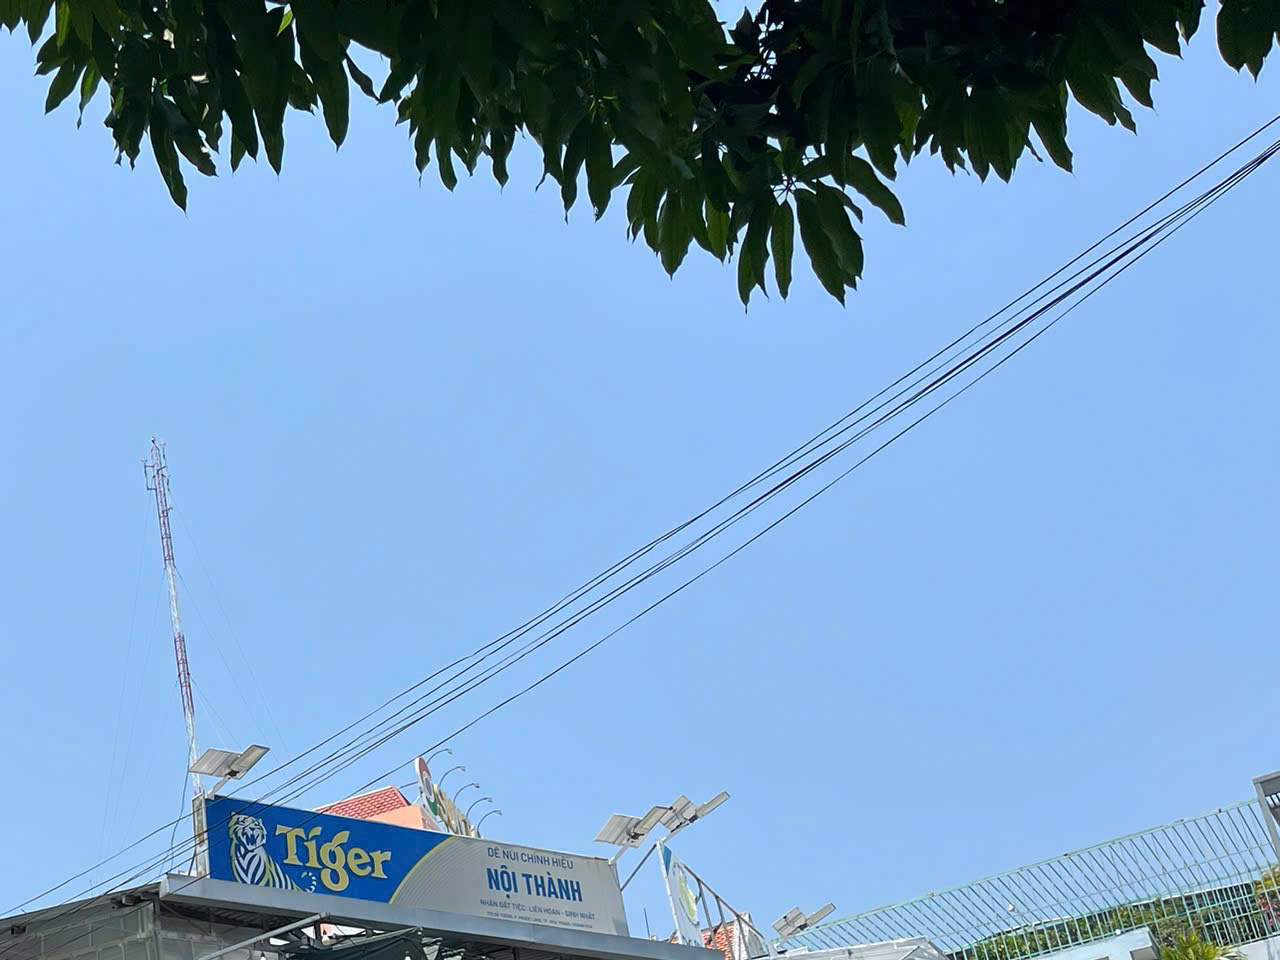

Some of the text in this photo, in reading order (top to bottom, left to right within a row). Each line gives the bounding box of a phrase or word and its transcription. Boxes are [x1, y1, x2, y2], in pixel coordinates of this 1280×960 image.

[275, 824, 392, 892] Tiger
[487, 846, 574, 870] DÊ NÚI CHÍNH HIỆU
[487, 864, 583, 902] NỘI THÀNH
